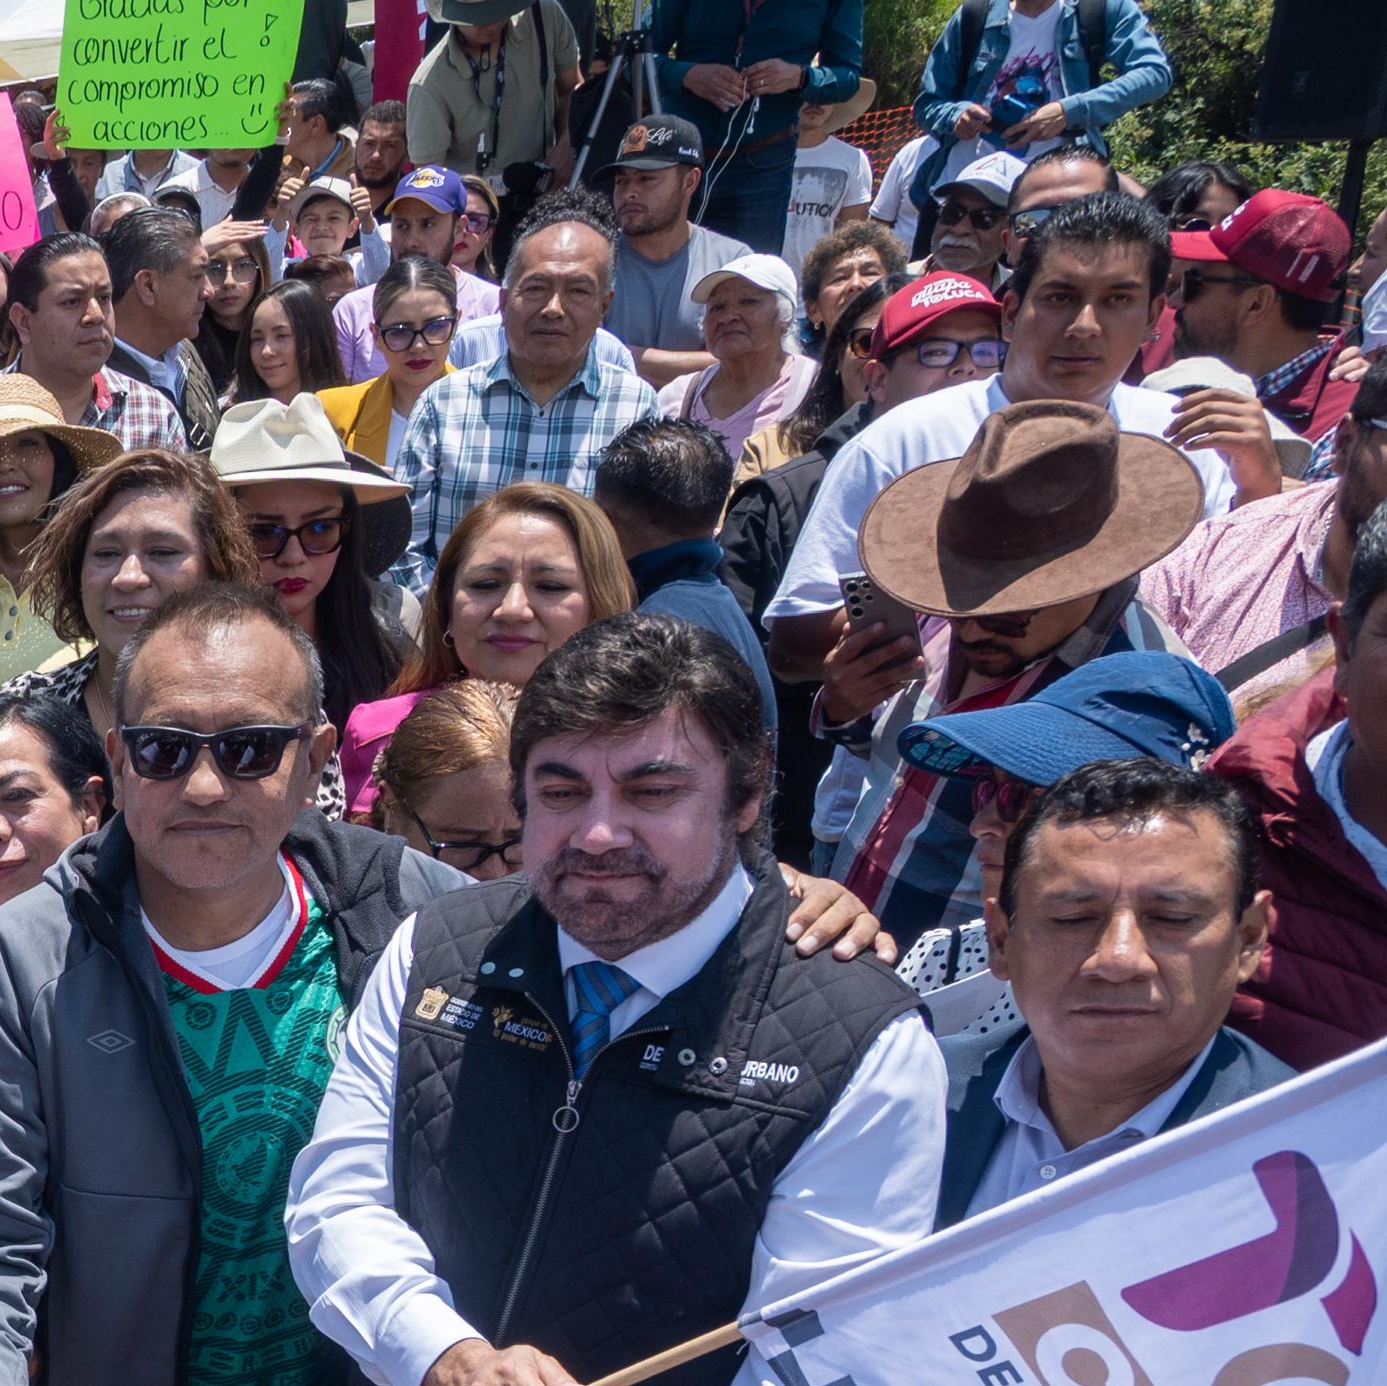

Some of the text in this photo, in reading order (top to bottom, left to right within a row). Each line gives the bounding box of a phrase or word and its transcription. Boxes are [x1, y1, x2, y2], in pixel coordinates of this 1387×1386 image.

[74, 23, 237, 66] convertir el
[68, 70, 265, 114] compromiso en
